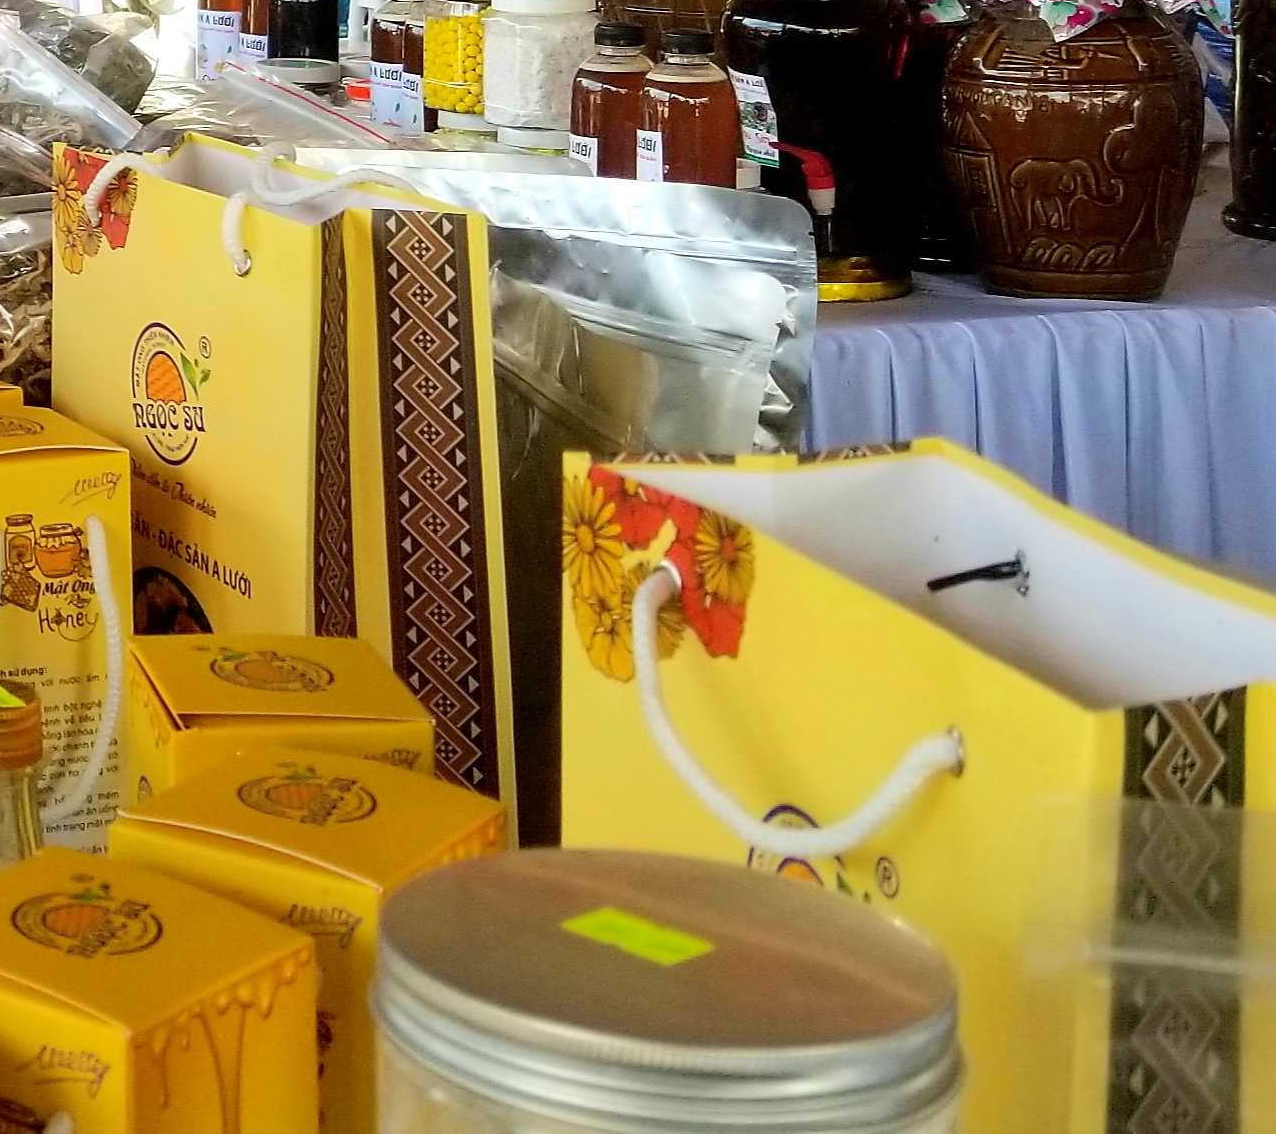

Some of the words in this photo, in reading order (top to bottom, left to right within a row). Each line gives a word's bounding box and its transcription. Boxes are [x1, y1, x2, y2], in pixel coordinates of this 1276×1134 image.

[132, 403, 179, 437] NGỌC
[182, 405, 207, 433] SU
[158, 529, 183, 559] ĐẶC
[185, 542, 210, 575] SẢN
[212, 560, 221, 582] A
[223, 565, 252, 600] LƯỚI
[42, 580, 69, 599] Mật
[71, 579, 97, 596] Ong
[38, 607, 100, 641] Honey
[21, 666, 48, 678] dụng:
